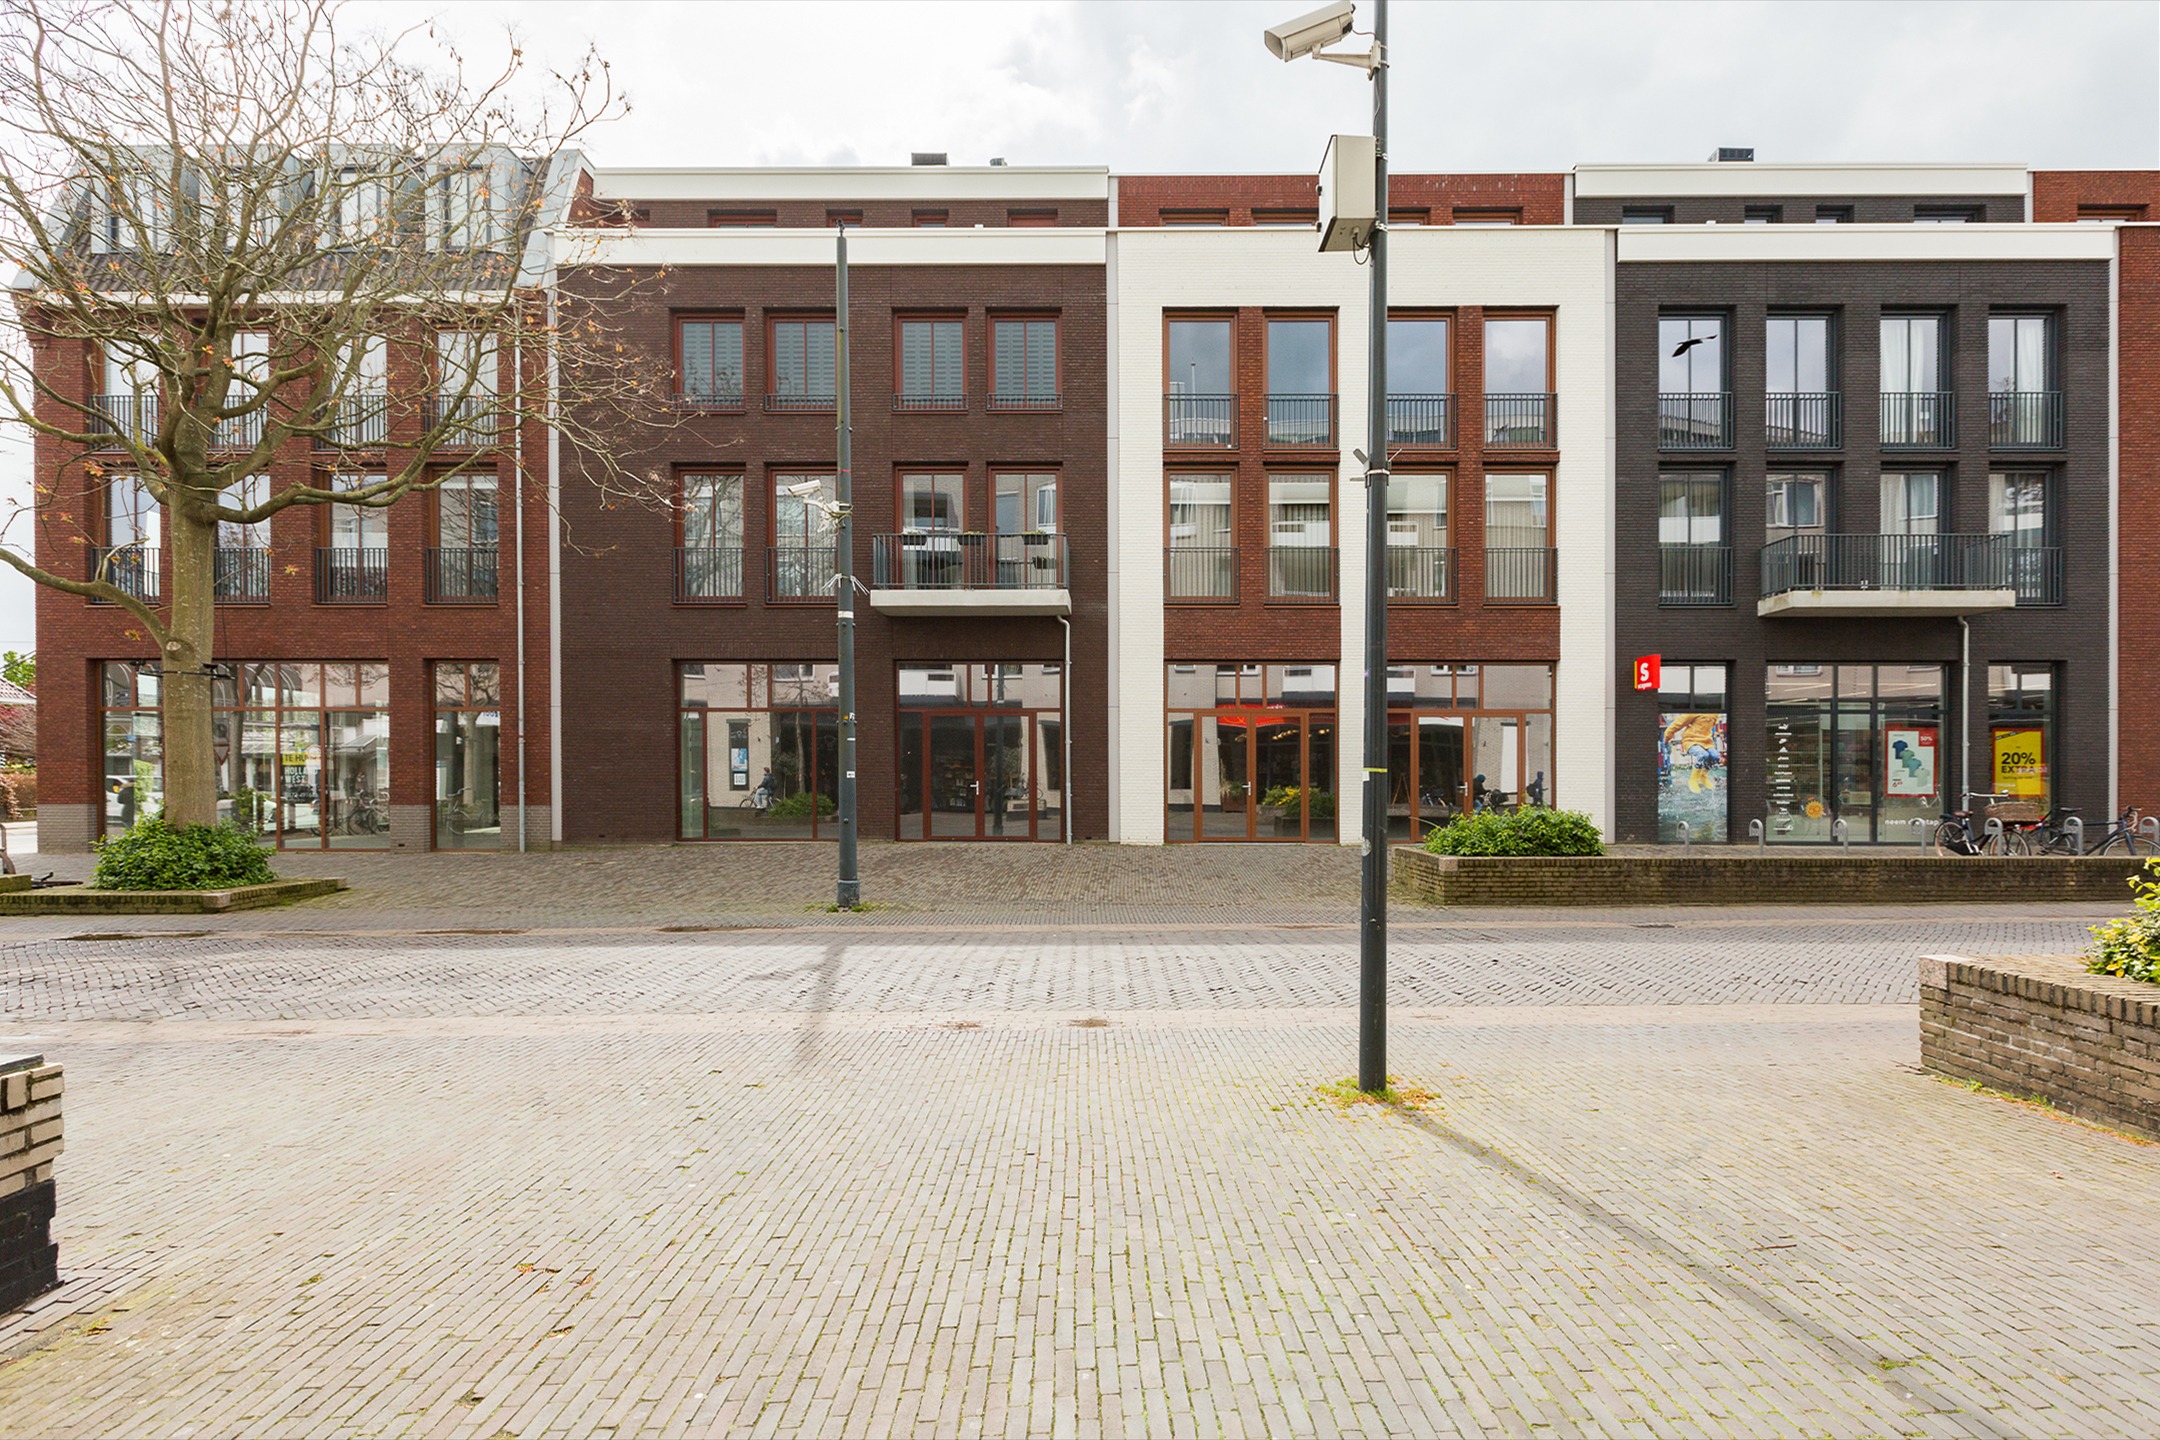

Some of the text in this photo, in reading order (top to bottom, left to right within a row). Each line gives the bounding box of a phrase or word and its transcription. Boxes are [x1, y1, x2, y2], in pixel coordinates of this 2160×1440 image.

[1640, 662, 1649, 681] S
[285, 754, 294, 762] TE
[2001, 752, 2036, 765] 20%
[2001, 765, 2036, 773] EXTRA
